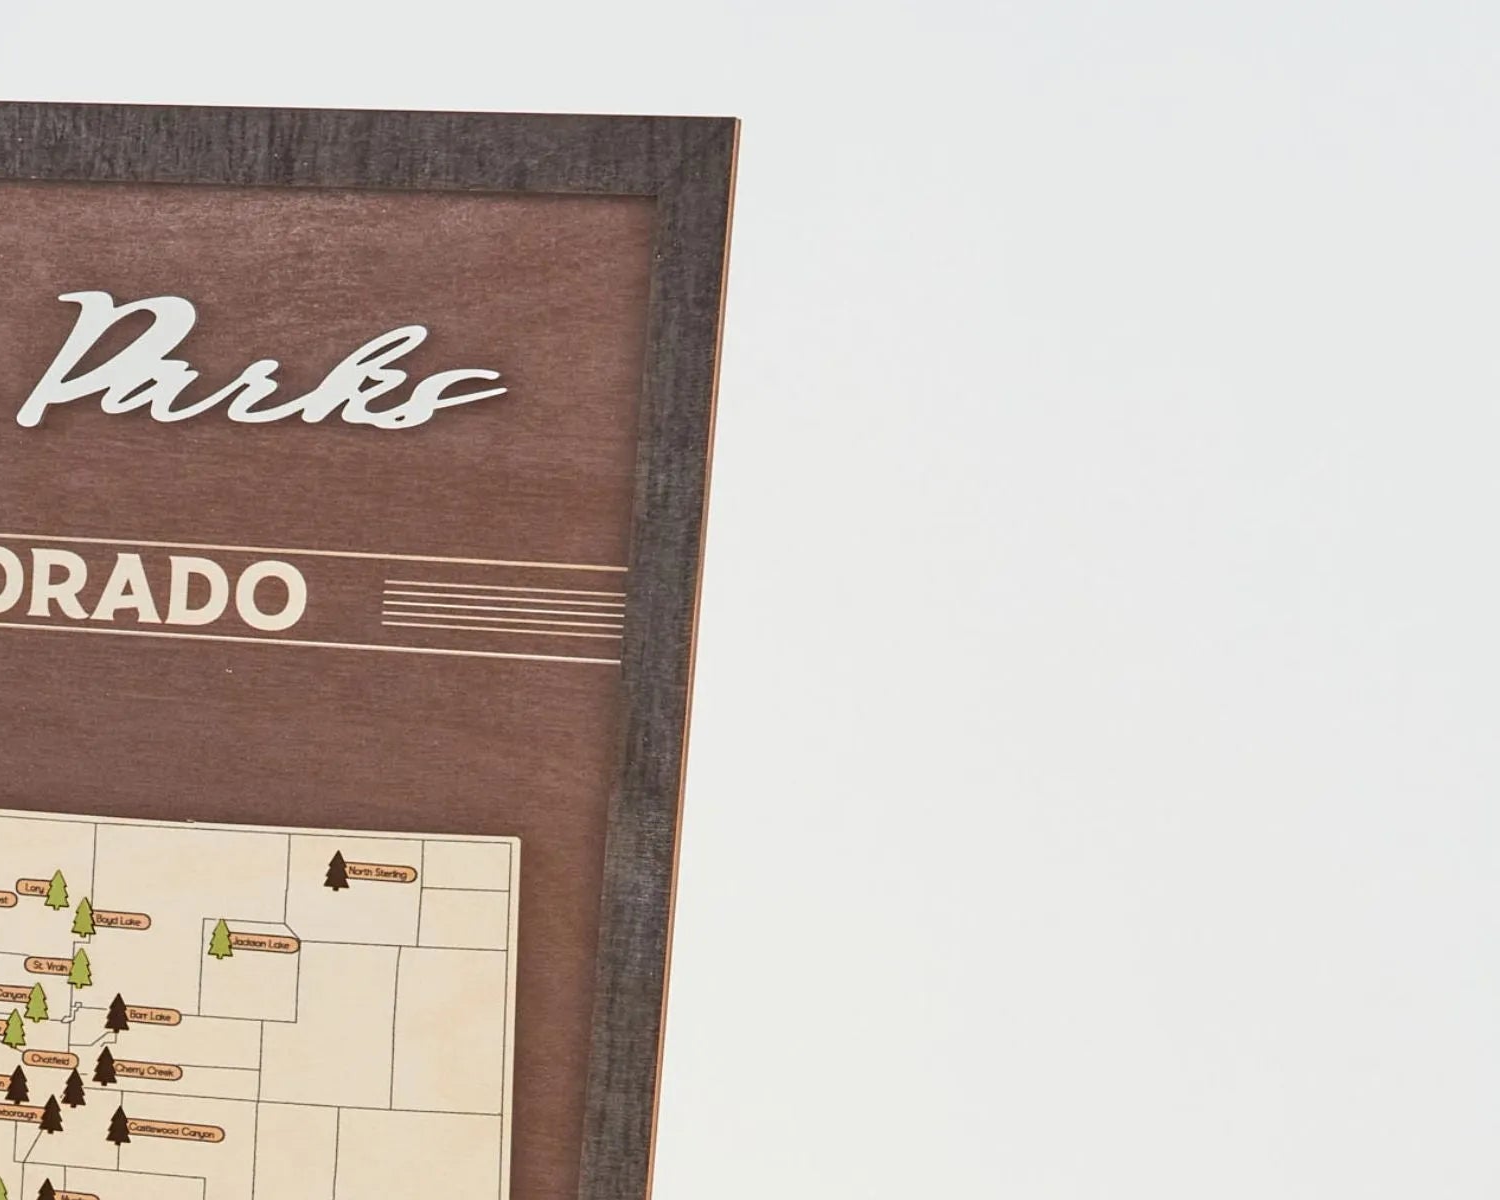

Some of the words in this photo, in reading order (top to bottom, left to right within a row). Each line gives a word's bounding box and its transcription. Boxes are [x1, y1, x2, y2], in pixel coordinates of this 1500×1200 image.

[16, 291, 508, 430] Parks
[349, 866, 372, 877] North
[375, 868, 407, 880] Sterling
[25, 883, 44, 894] Lory
[96, 914, 118, 925] Boyd
[120, 916, 141, 926] Lake
[233, 938, 265, 949] Jackson
[268, 940, 289, 950] Lake
[129, 1010, 148, 1020] Barr
[150, 1011, 171, 1021] Lake
[31, 1054, 69, 1065] Chatfield
[115, 1063, 145, 1075] Cherry
[147, 1066, 174, 1076] Creek
[129, 1122, 179, 1135] Castlewood
[182, 1127, 215, 1140] Canyon
